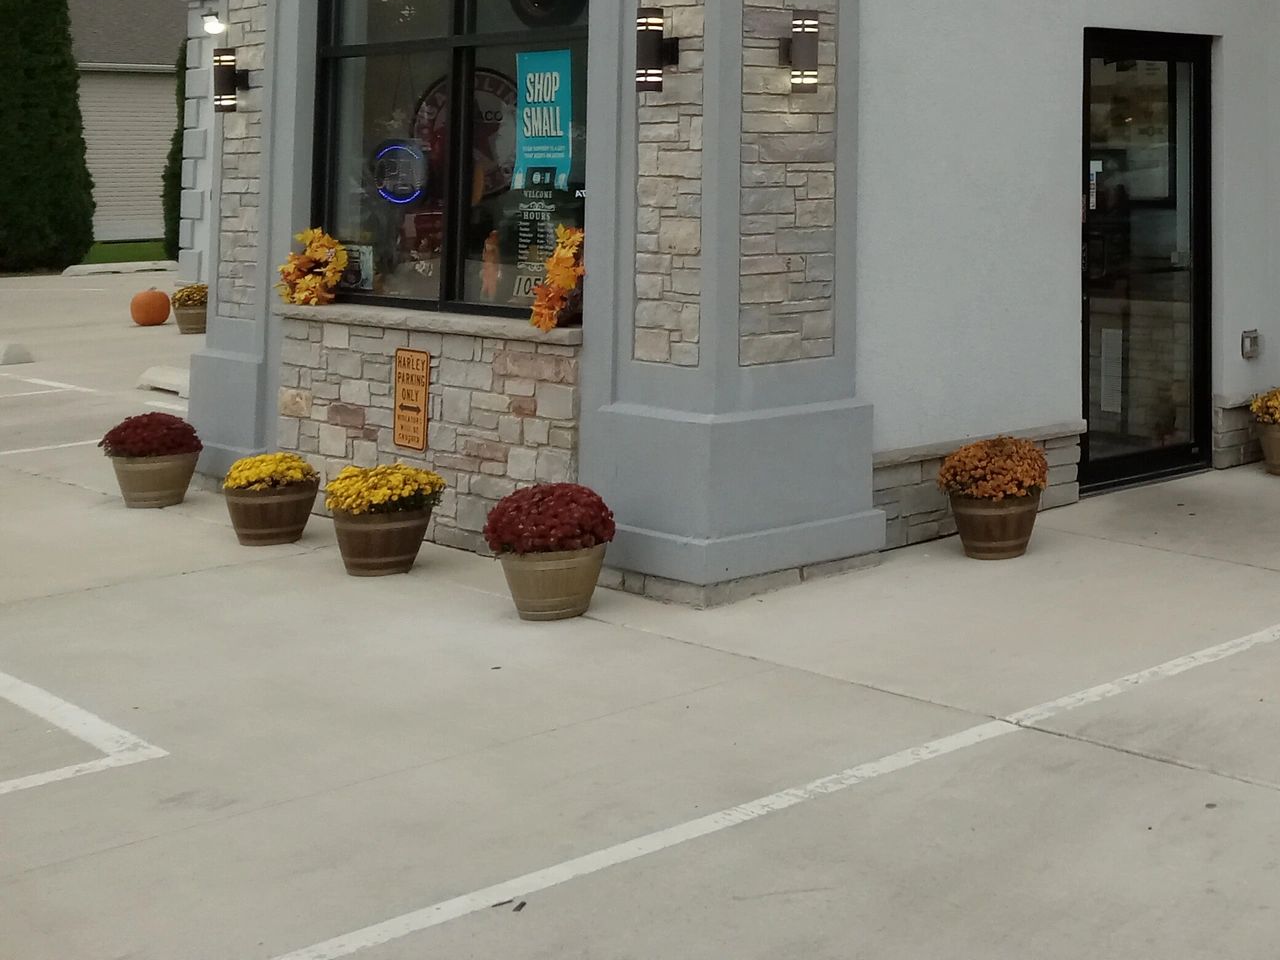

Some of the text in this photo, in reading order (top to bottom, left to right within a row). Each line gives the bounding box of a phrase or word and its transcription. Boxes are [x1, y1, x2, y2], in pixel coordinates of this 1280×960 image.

[525, 71, 560, 104] SHOP
[523, 106, 564, 138] SMALL
[523, 190, 553, 199] WELCOME
[523, 211, 551, 220] HOURS
[397, 355, 426, 371] HARLEY
[397, 372, 425, 387] PARKING
[401, 388, 419, 402] ONLY
